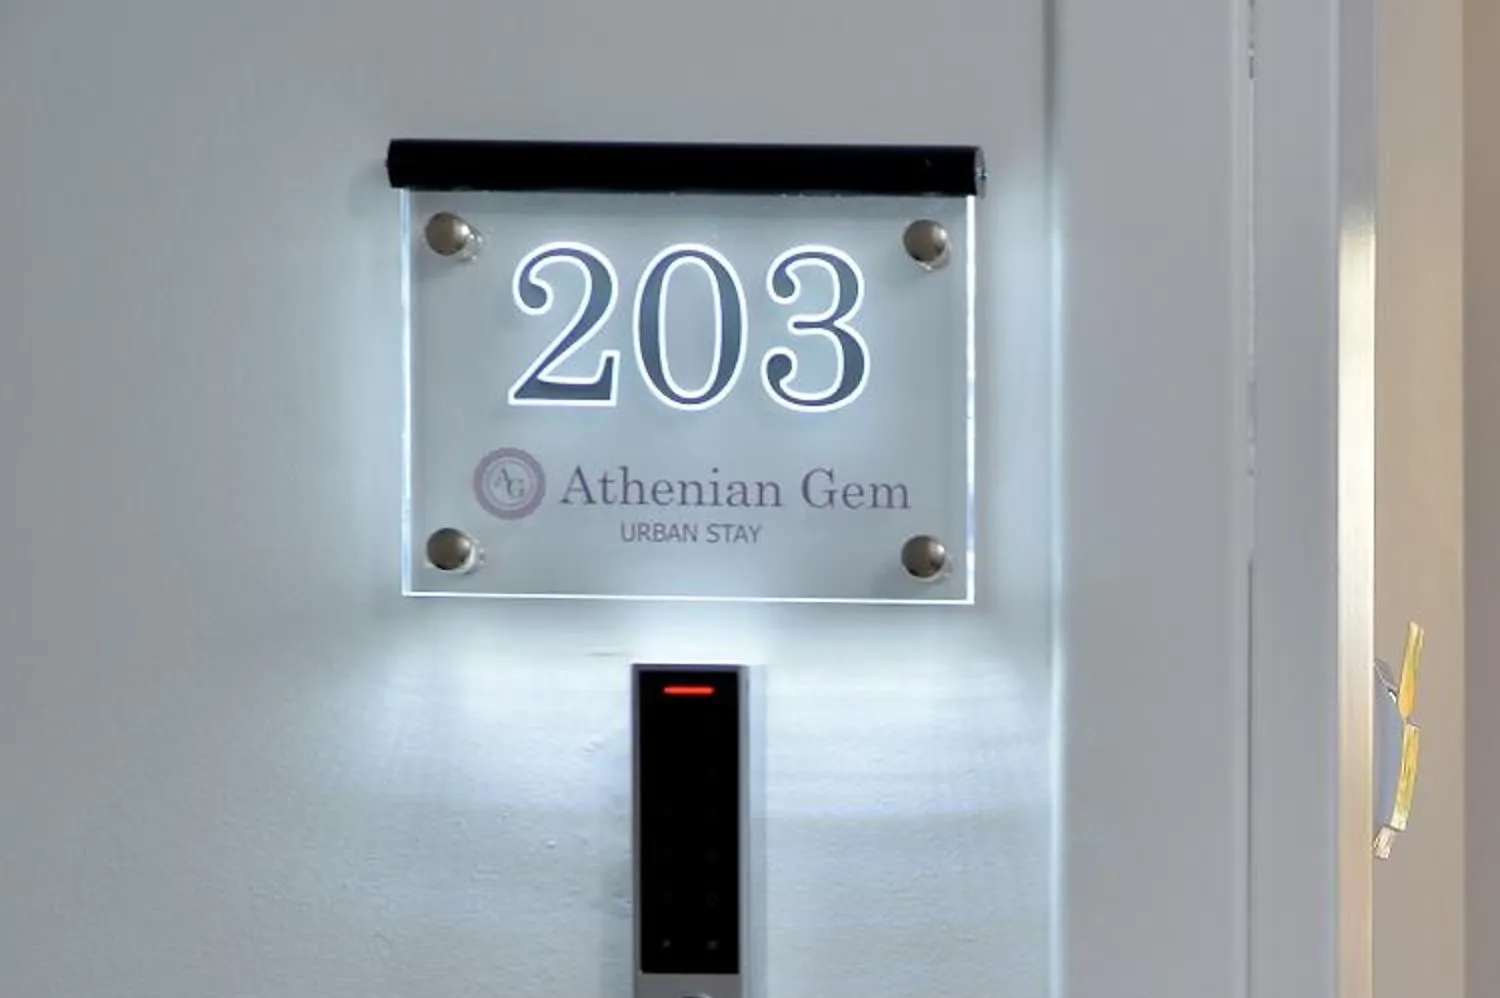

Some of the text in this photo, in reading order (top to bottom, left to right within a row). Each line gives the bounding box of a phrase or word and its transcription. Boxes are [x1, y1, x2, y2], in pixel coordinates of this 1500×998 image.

[508, 241, 871, 411] 203
[560, 466, 911, 510] Athenian Gem
[620, 523, 763, 544] URBAN STAY
